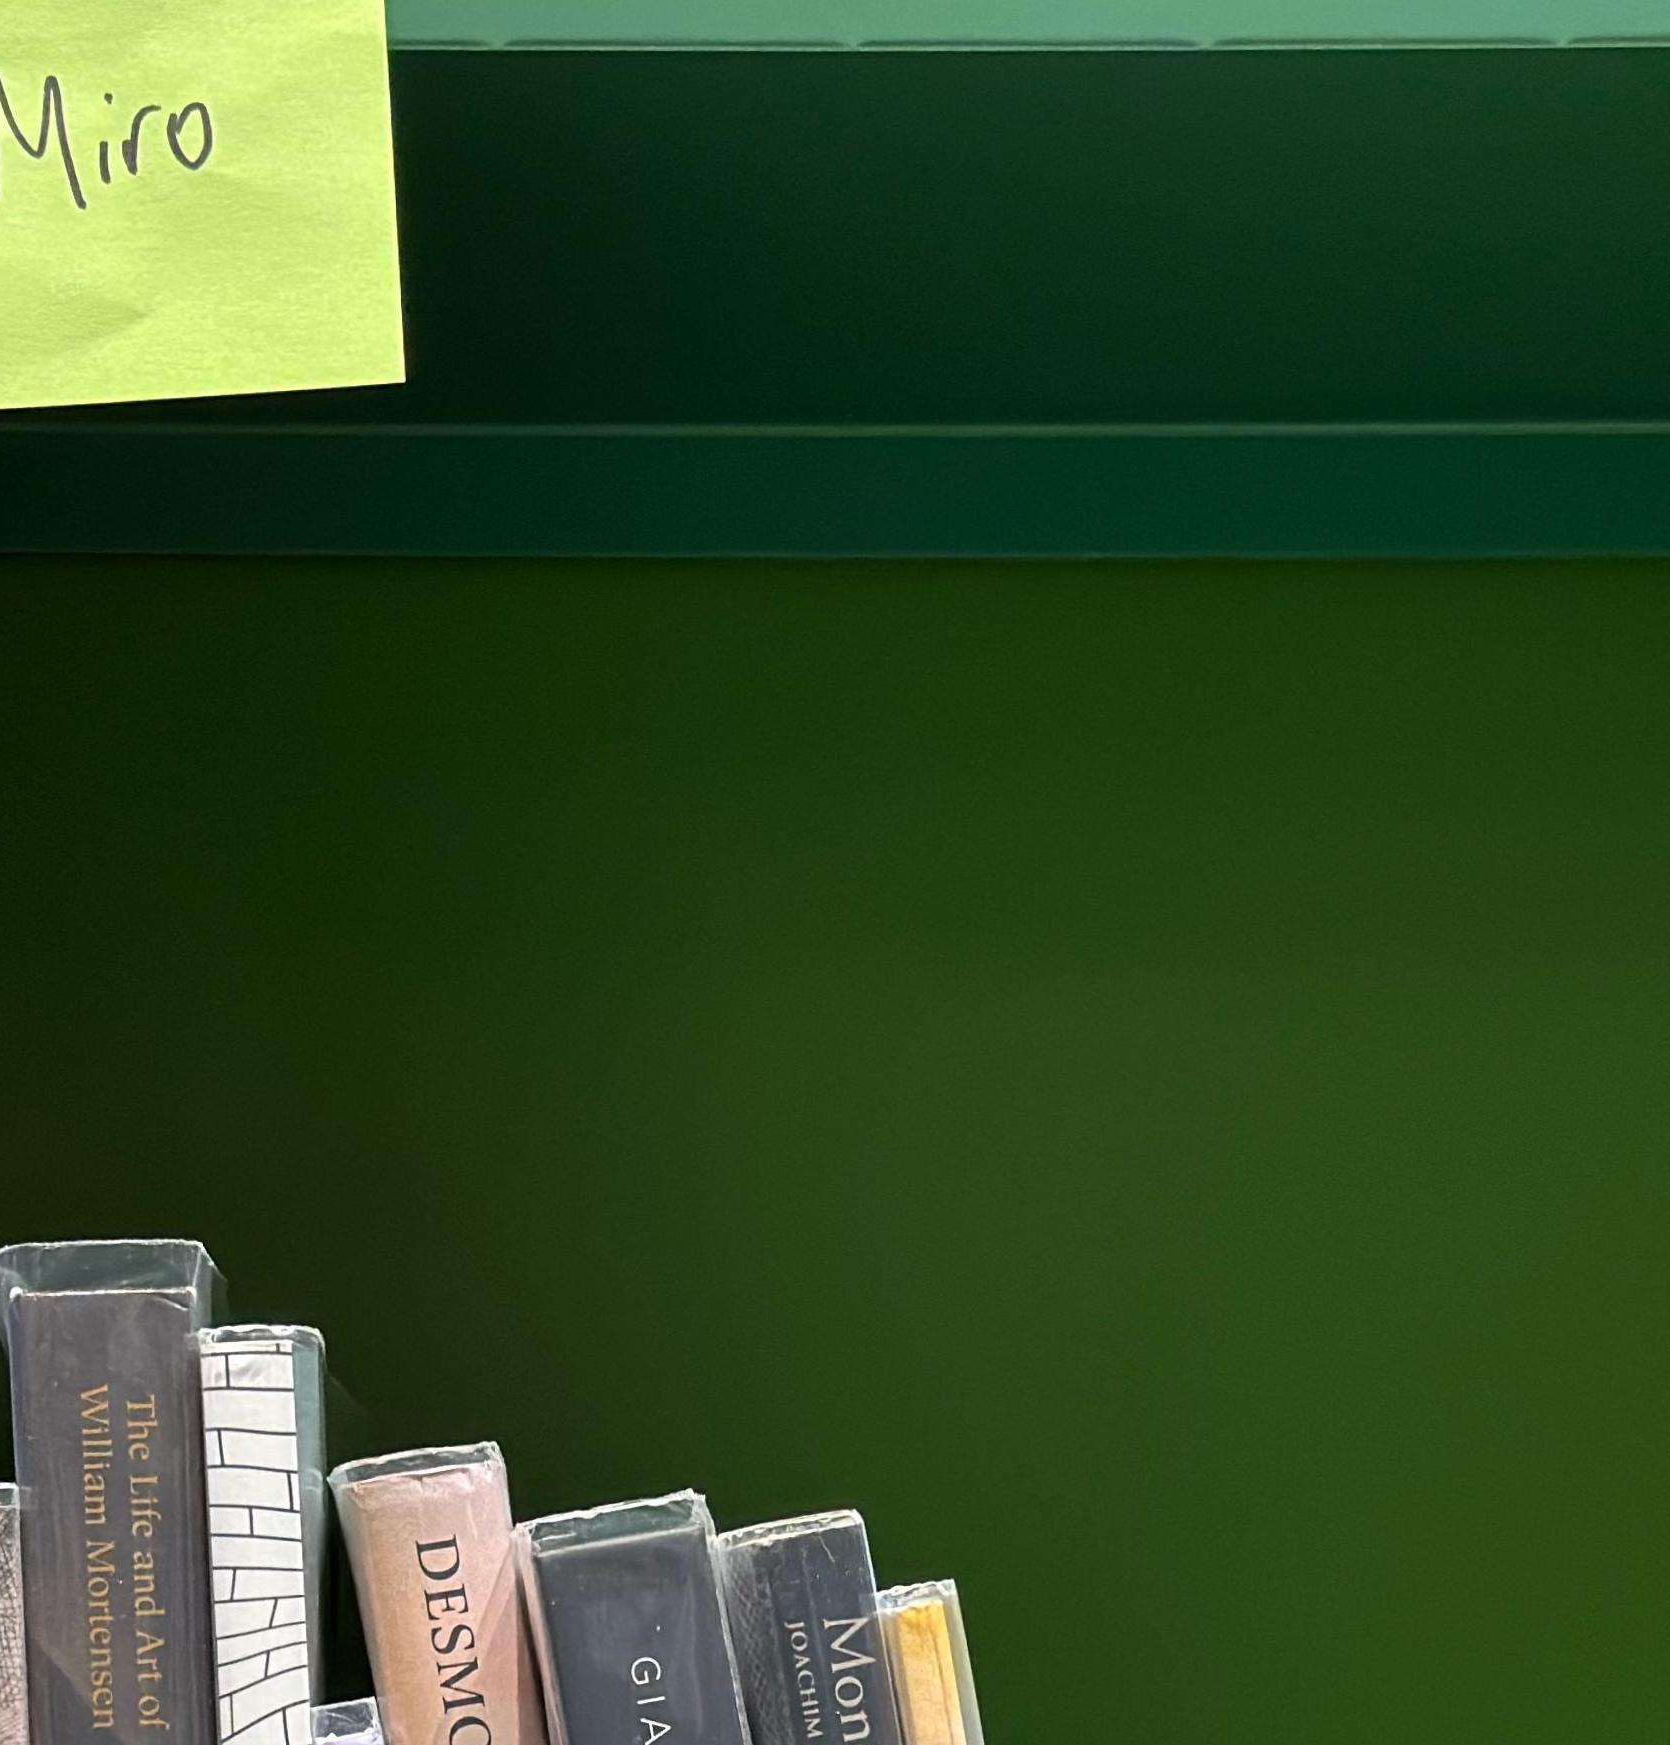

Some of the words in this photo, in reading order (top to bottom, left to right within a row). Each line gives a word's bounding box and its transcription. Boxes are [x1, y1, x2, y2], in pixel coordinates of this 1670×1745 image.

[80, 1384, 114, 1525] William
[125, 1394, 158, 1461] The
[129, 1475, 161, 1537] Life
[132, 1551, 166, 1616] and
[85, 1540, 117, 1730] Mortensen
[135, 1630, 166, 1682] Art
[783, 1619, 823, 1739] JOACHIM
[138, 1695, 170, 1730] of
